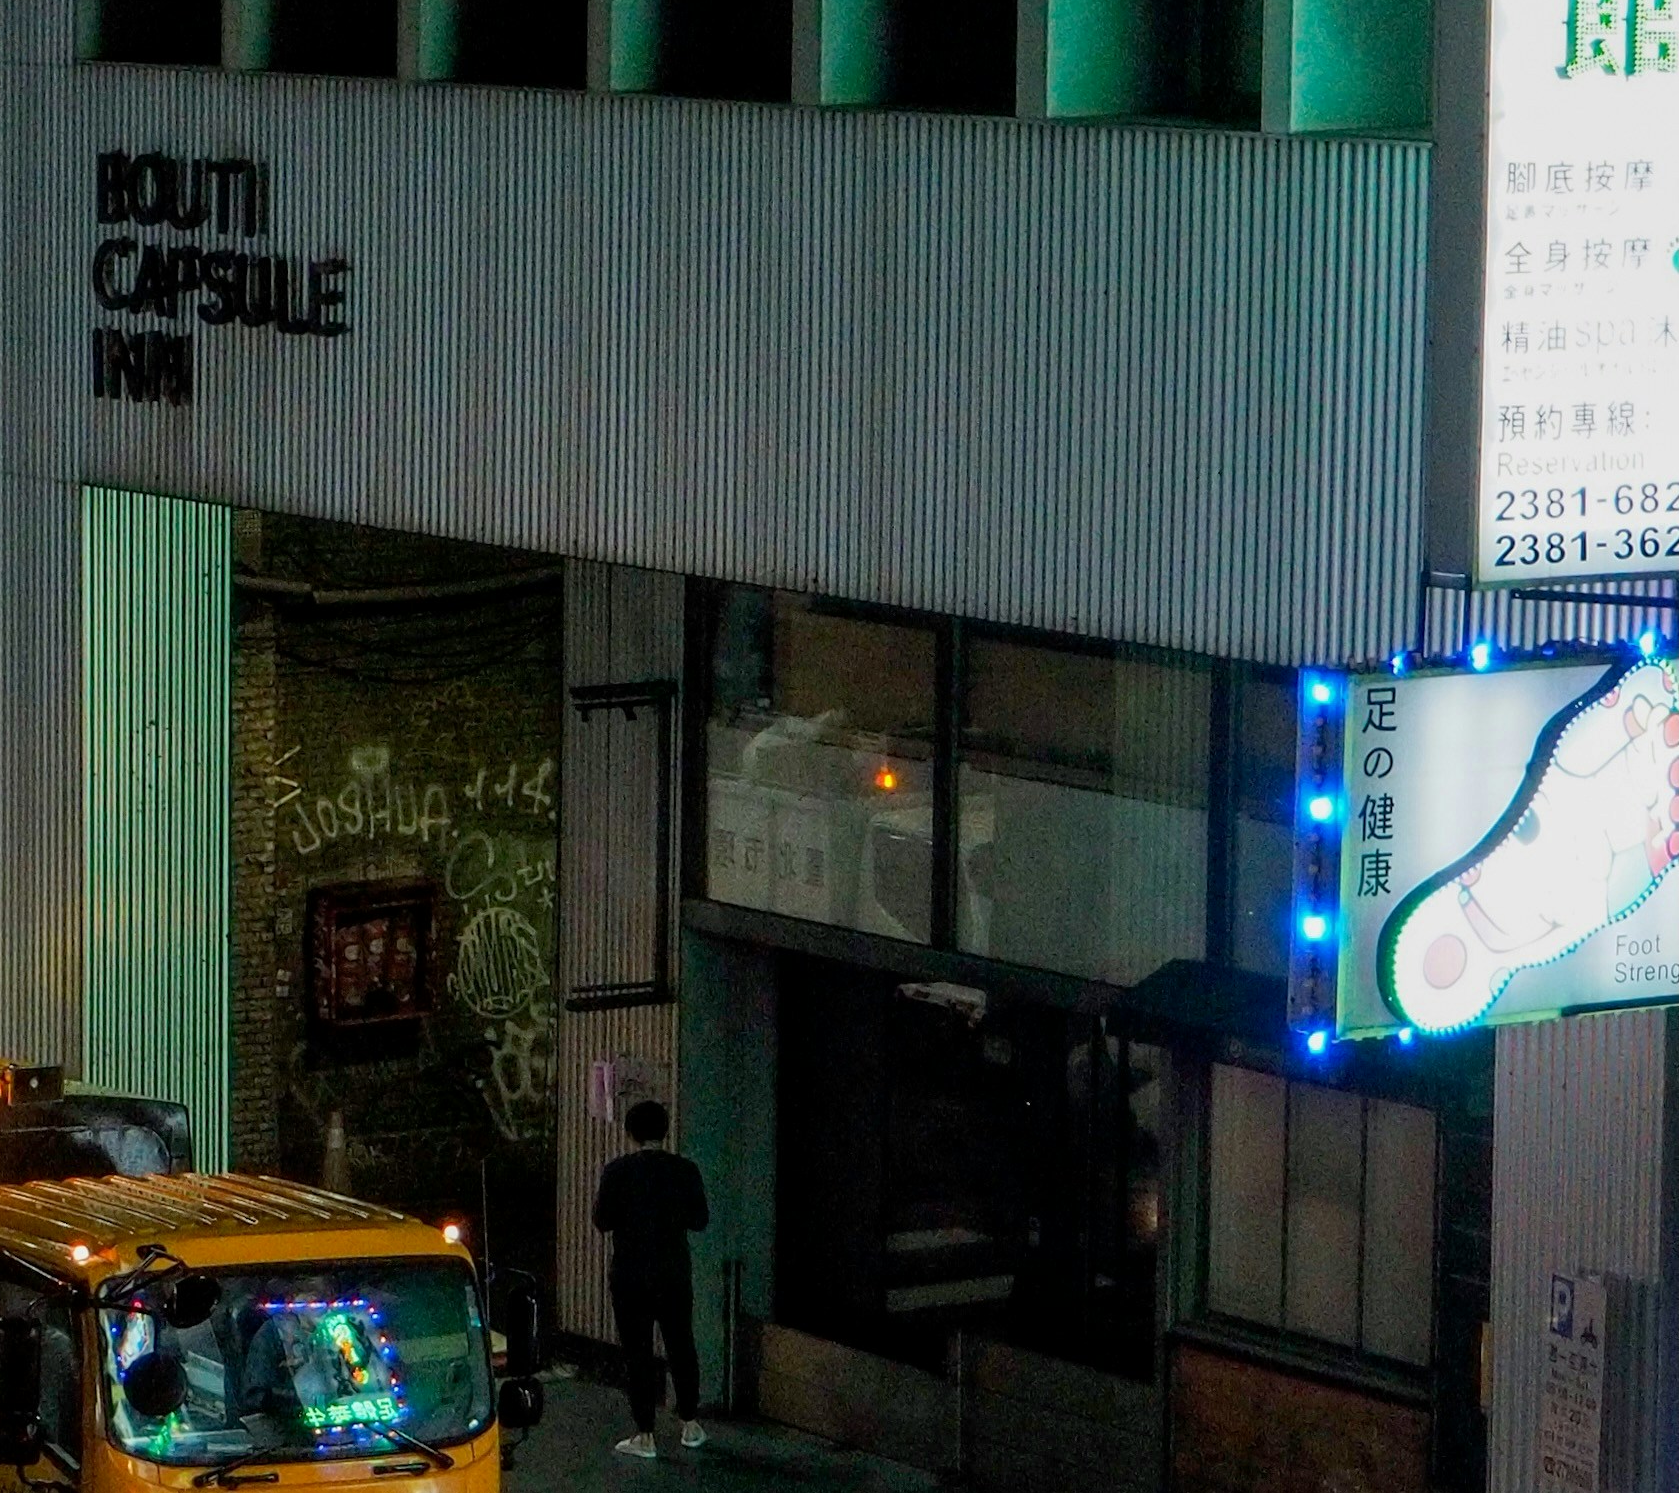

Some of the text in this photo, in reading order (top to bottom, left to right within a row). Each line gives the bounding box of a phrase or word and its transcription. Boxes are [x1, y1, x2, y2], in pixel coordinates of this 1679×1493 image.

[1506, 159, 1655, 195] 腳底按摩
[1503, 238, 1653, 275] 全身按摩
[93, 236, 351, 337] CAPSULE
[92, 327, 194, 406] INN
[1497, 450, 1645, 478] Reservation
[1356, 686, 1398, 898] 足の健康
[1615, 933, 1661, 956] Foot
